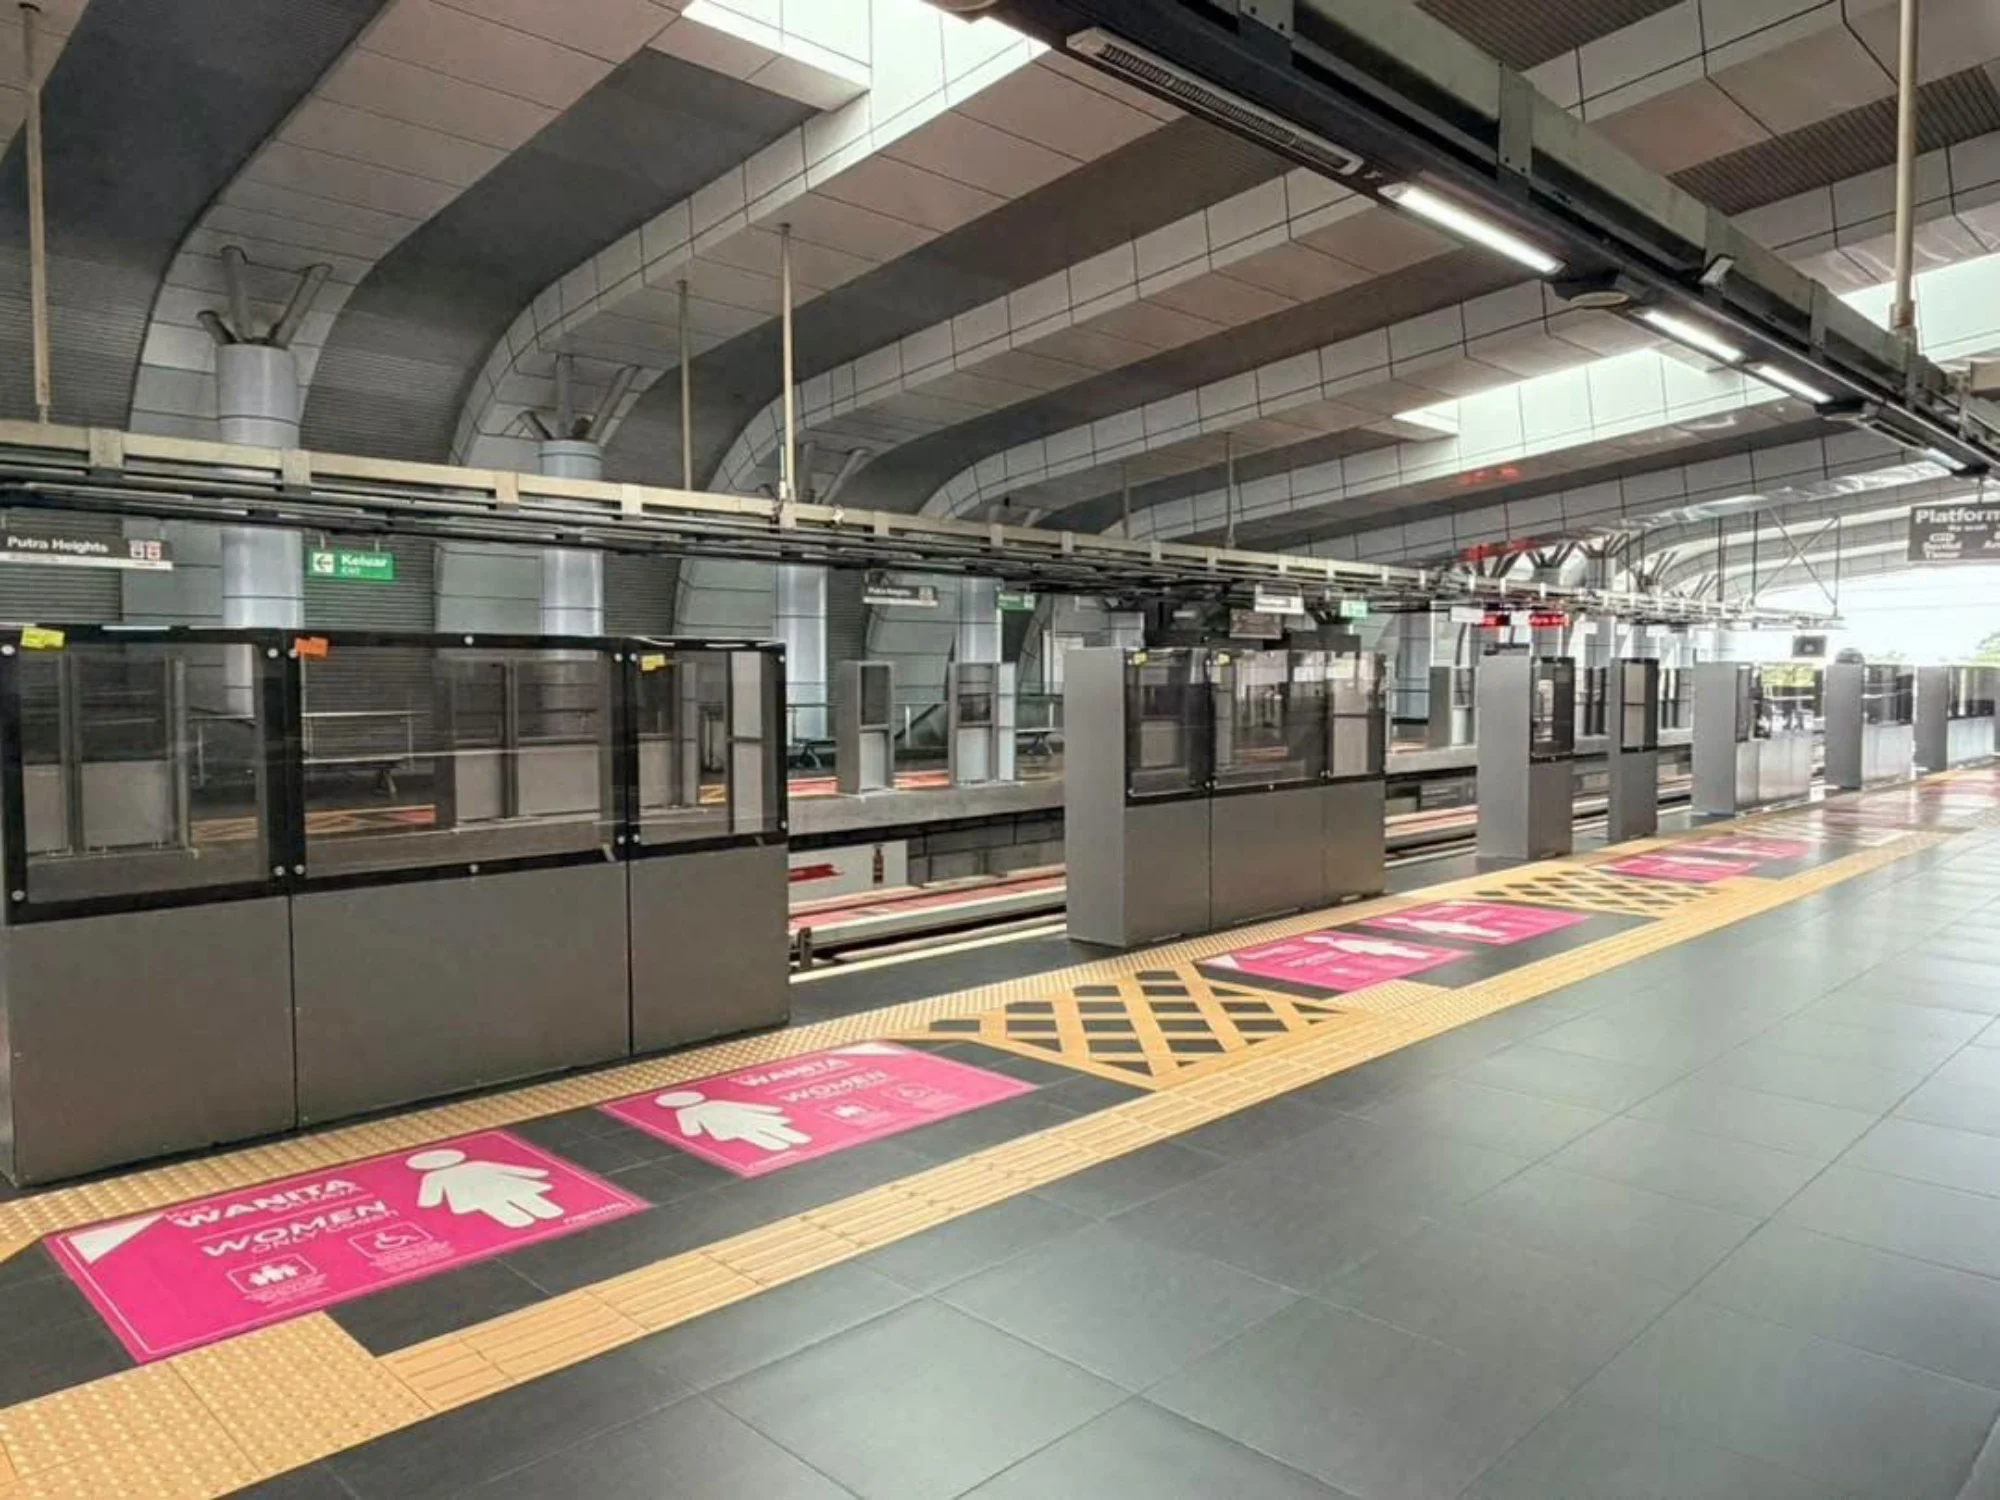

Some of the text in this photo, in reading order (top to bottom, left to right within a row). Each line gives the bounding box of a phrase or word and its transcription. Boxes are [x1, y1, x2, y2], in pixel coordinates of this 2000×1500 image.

[7, 536, 109, 554] Putra Heights
[341, 554, 388, 568] Keluar
[780, 1070, 889, 1103] WOMEN
[173, 1179, 358, 1228] WANITA
[202, 1200, 388, 1257] WOMEN
